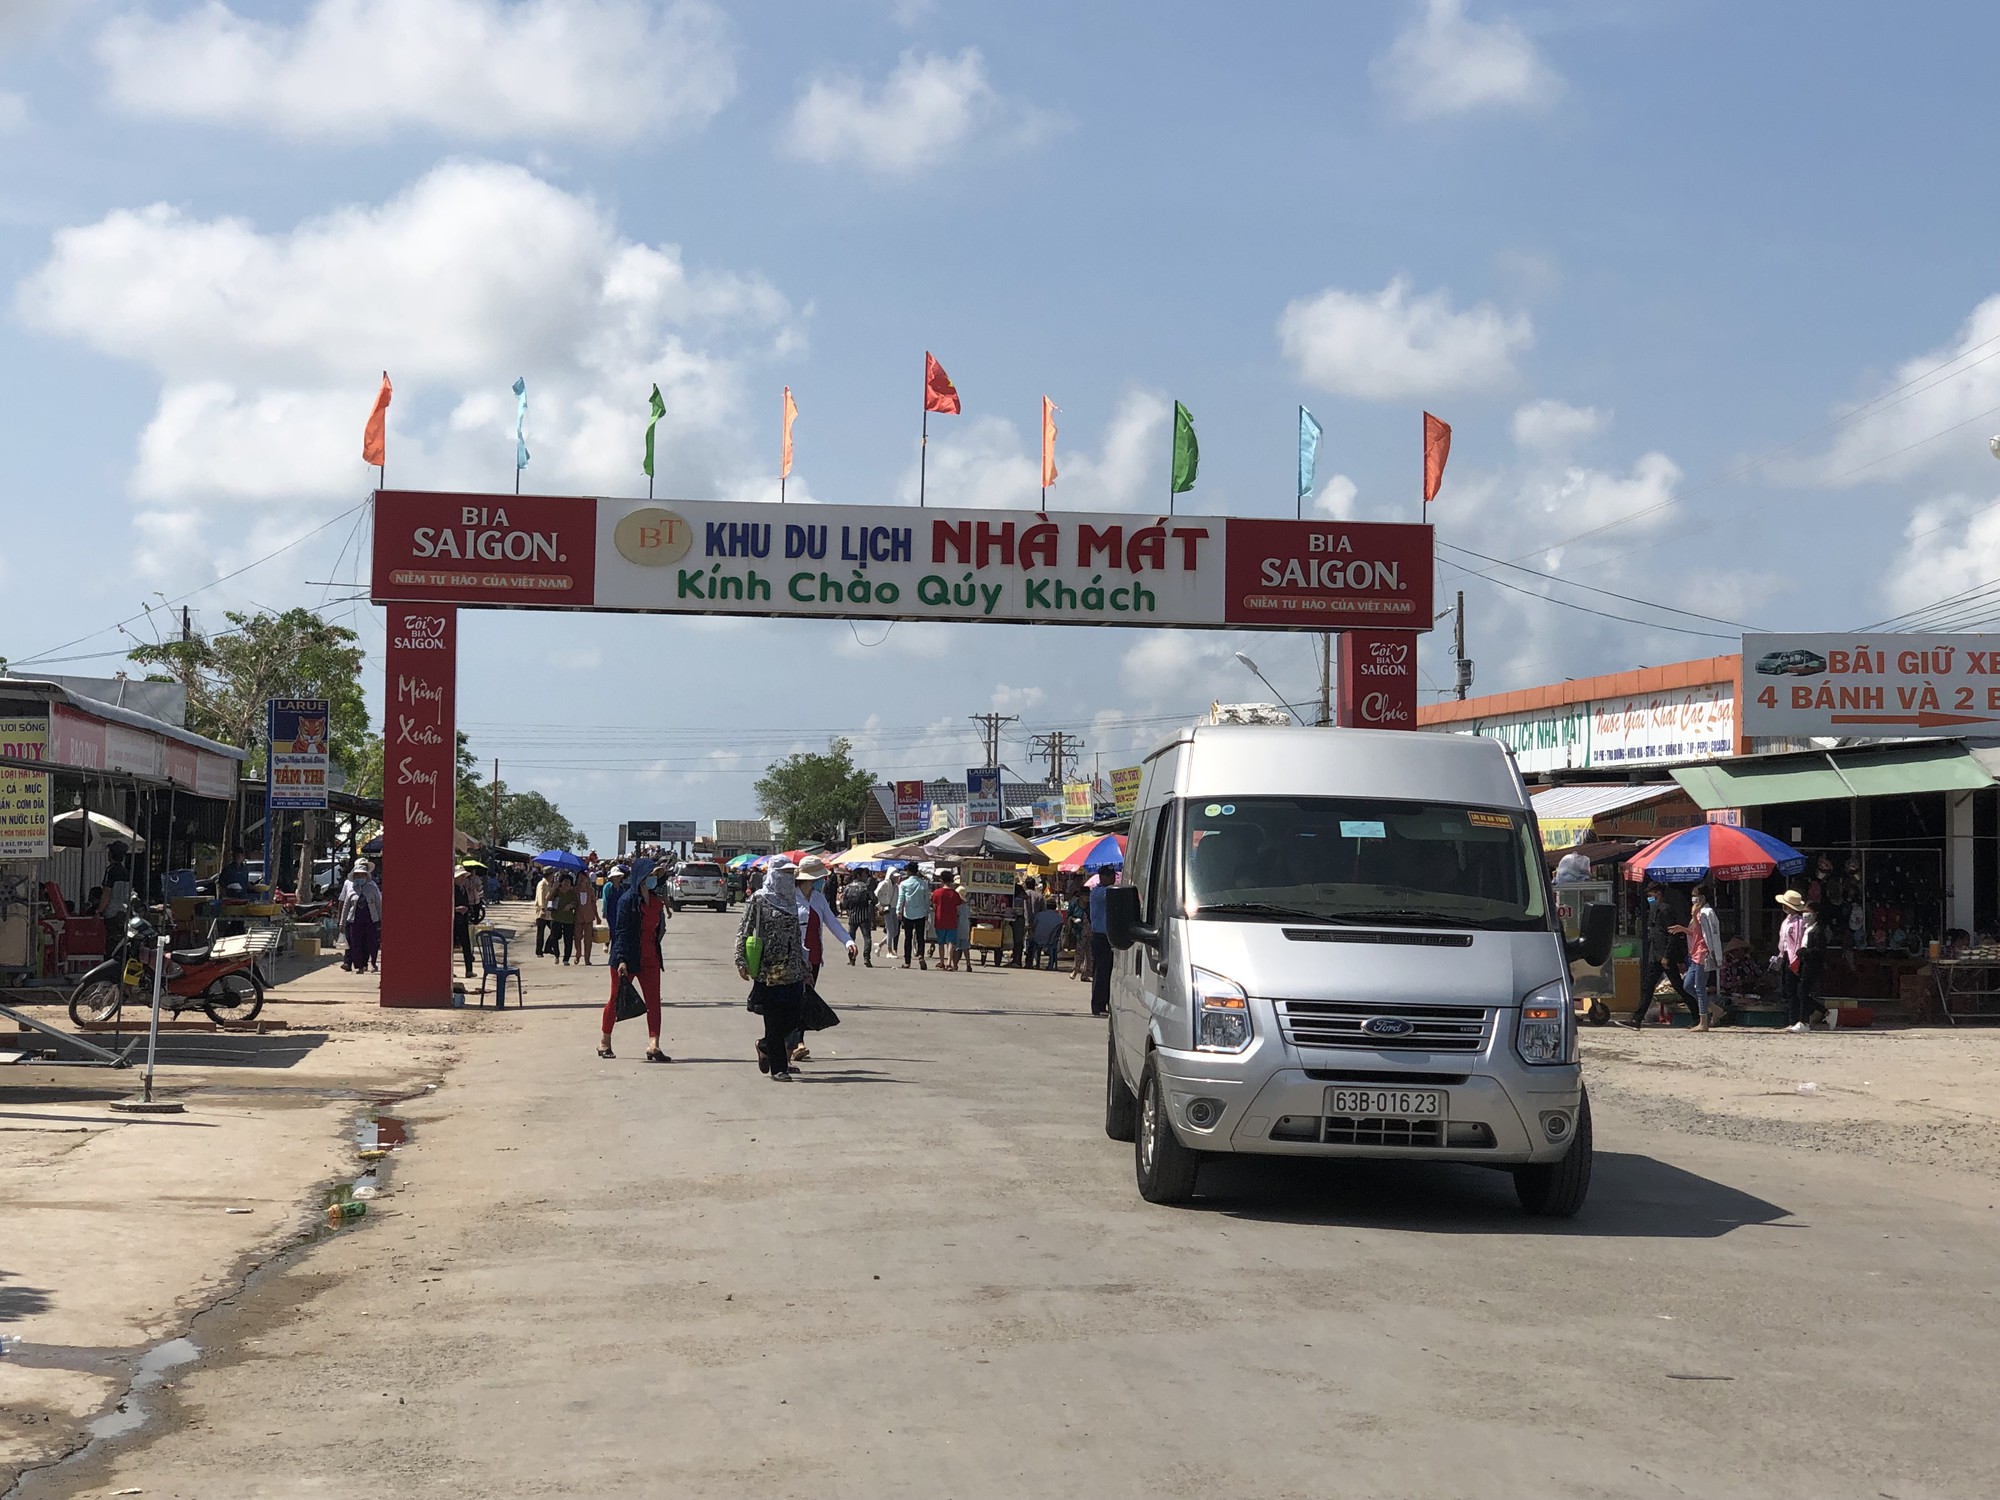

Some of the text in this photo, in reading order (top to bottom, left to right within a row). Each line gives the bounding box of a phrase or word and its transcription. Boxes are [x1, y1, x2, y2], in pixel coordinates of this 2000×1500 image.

[462, 506, 510, 527] BIA
[639, 519, 683, 548] BT
[705, 512, 1210, 575] KHU DU LỊCH NHÀ MÁT
[1309, 533, 1353, 553] BIA
[395, 571, 568, 589] NIỀM TỰ HÀO CỦA VIỆT NAM
[677, 562, 771, 601] Kính
[788, 569, 900, 604] Chào
[1025, 574, 1156, 611] Khách
[1250, 595, 1411, 613] NIỀM TỰ HÀO CỦA VIỆT NAM
[404, 615, 428, 630] Tôi
[411, 630, 426, 638] BIA
[1369, 642, 1391, 656] Tôi
[1828, 645, 1885, 674] BÃI
[1897, 645, 1956, 675] GIỮ
[277, 701, 326, 710] LARUE
[398, 674, 443, 725] Mừng
[1361, 691, 1408, 723] Chúc
[1757, 686, 1779, 709] 4
[1791, 679, 1884, 710] BÁNH
[1896, 680, 1941, 710] VÀ
[1954, 687, 1974, 710] 2
[397, 714, 443, 745] Xuân
[1537, 709, 1558, 750] NHÀ
[397, 756, 438, 809] Sang
[405, 796, 434, 828] Vạn
[1374, 1020, 1401, 1032] Ford
[1336, 1091, 1436, 1113] 63B-016.23
